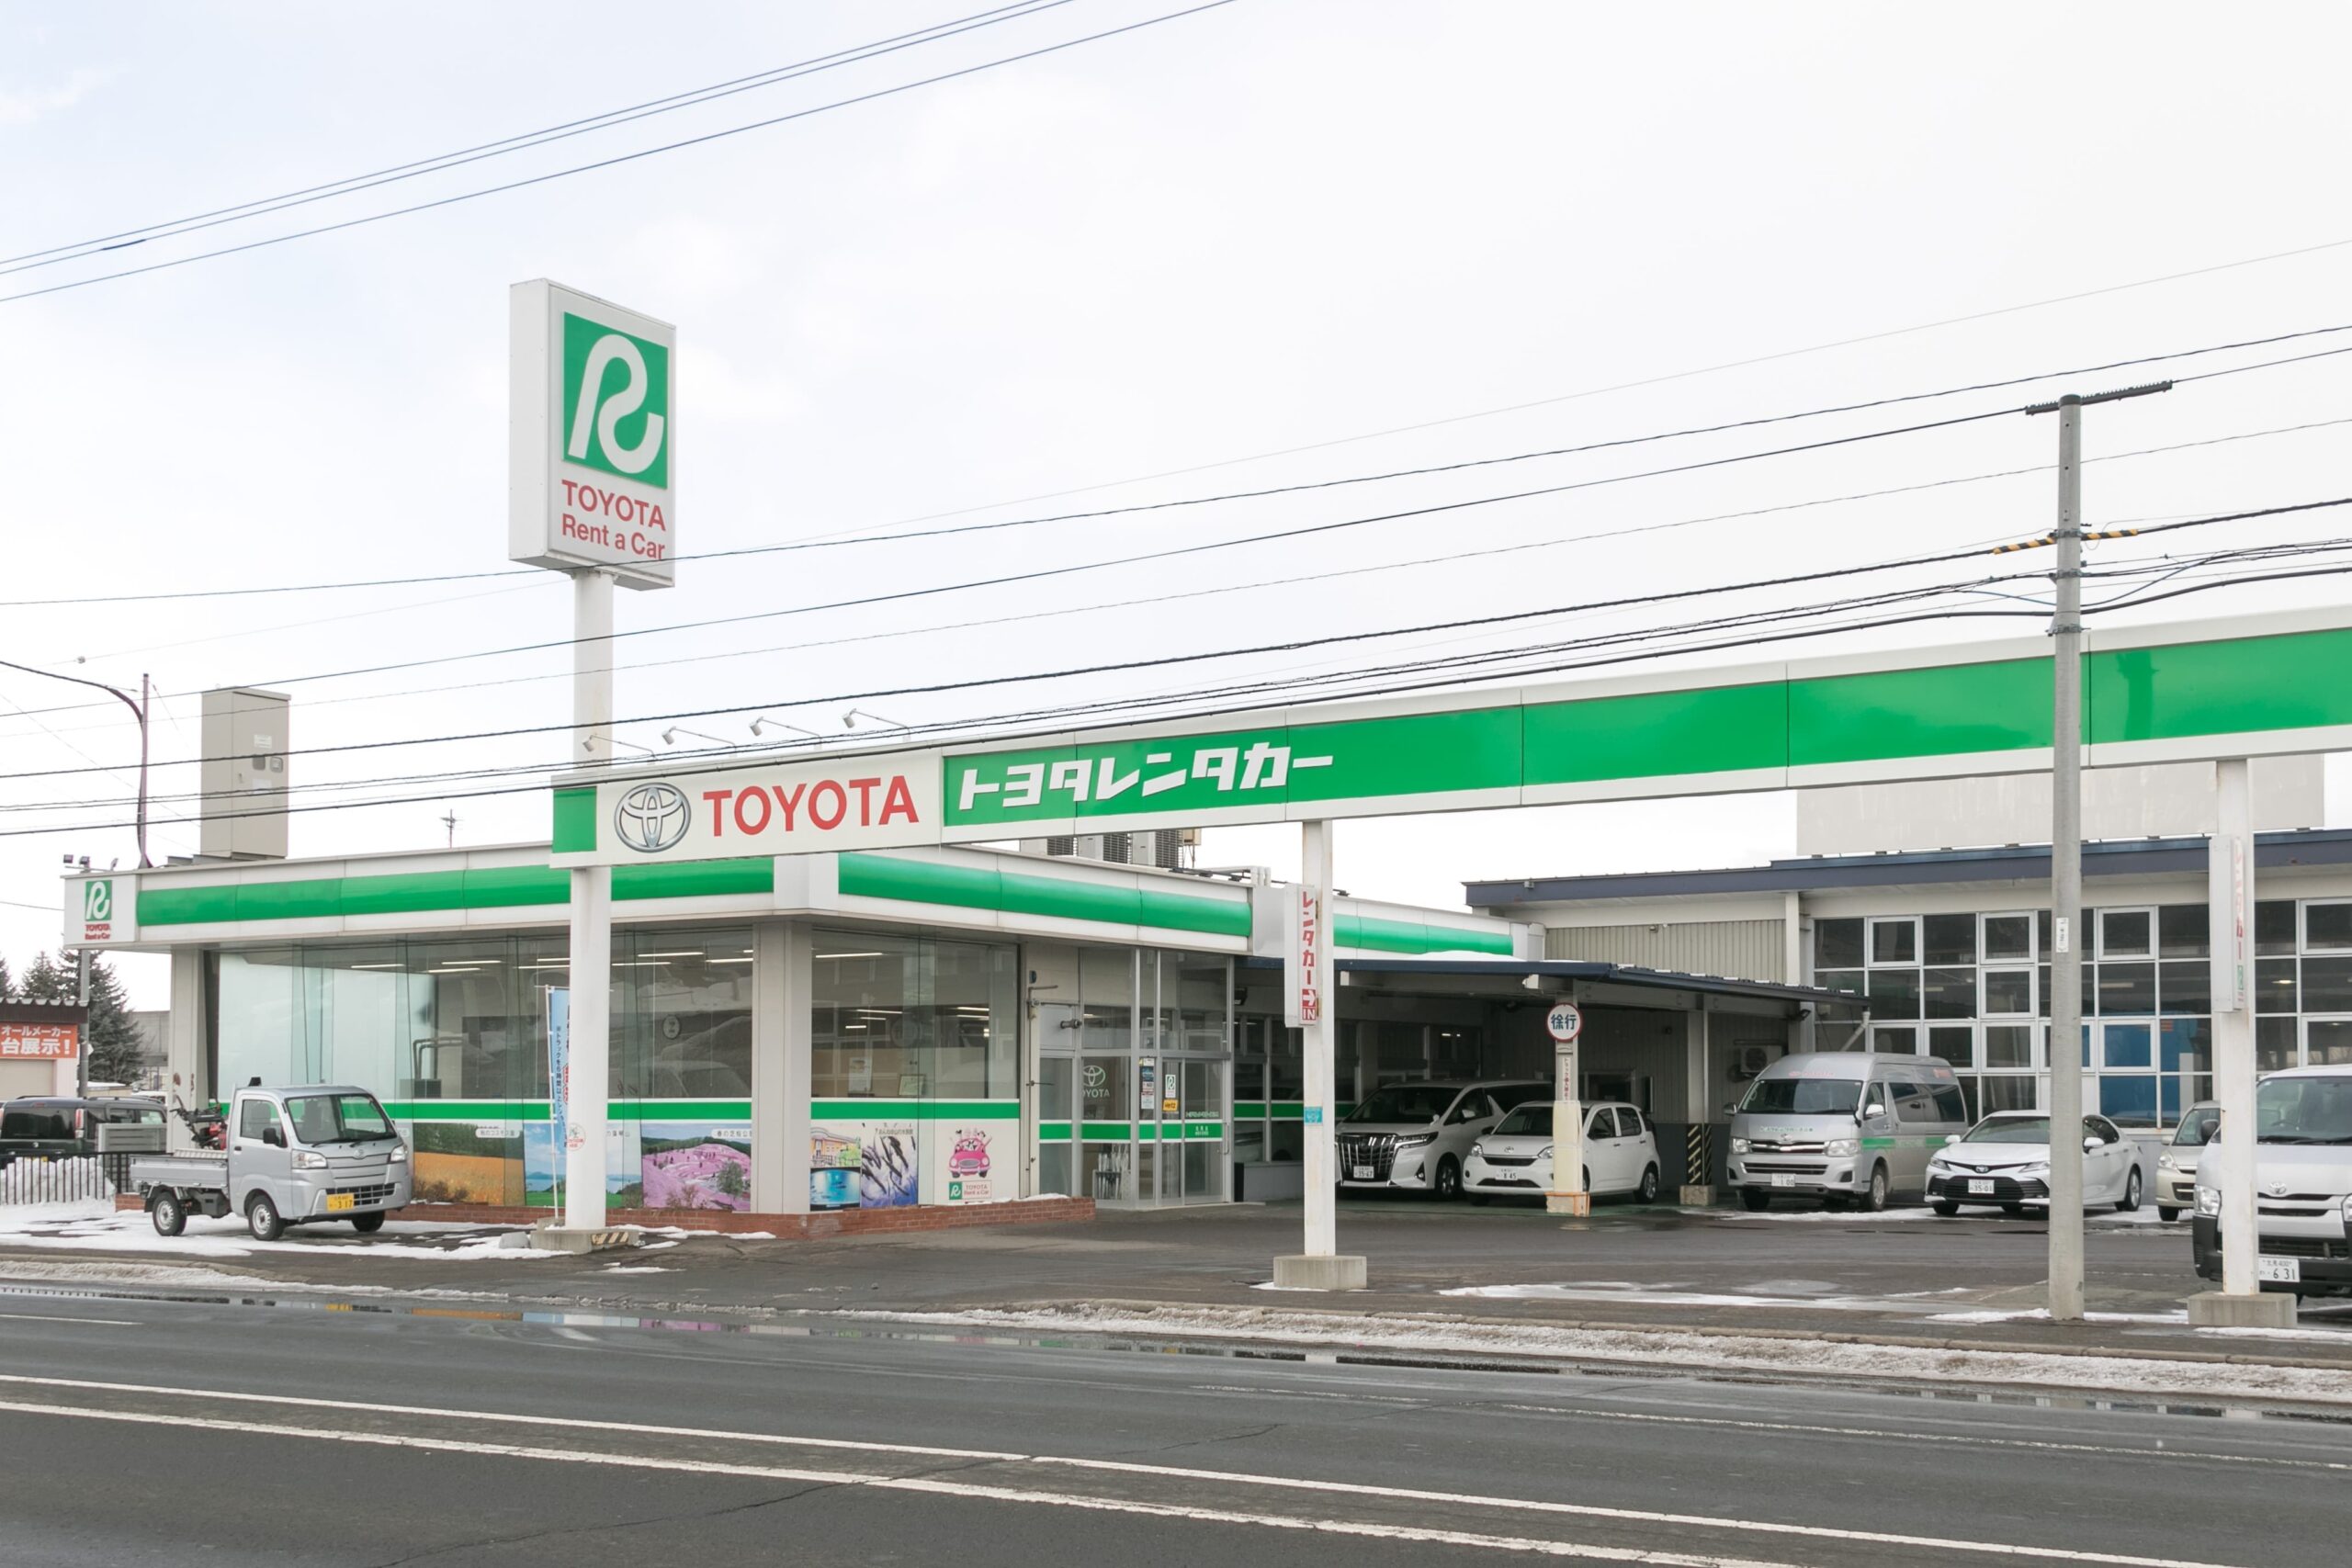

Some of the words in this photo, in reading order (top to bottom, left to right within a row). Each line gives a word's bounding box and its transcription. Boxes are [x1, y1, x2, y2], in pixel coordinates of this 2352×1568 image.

[561, 479, 666, 532] TOYOTA
[562, 513, 609, 547] Rent
[615, 533, 626, 551] a
[631, 532, 665, 560] Car
[958, 741, 1334, 811] トヨタレンタカー
[703, 774, 920, 837] TOYOTA
[85, 923, 111, 931] TOYOTA
[1302, 890, 1316, 986] レンタカー
[1, 1024, 72, 1037] オールメーカー
[1303, 1009, 1316, 1021] IN
[1550, 1013, 1577, 1030] 徐行
[1081, 1088, 1111, 1098] YOTA
